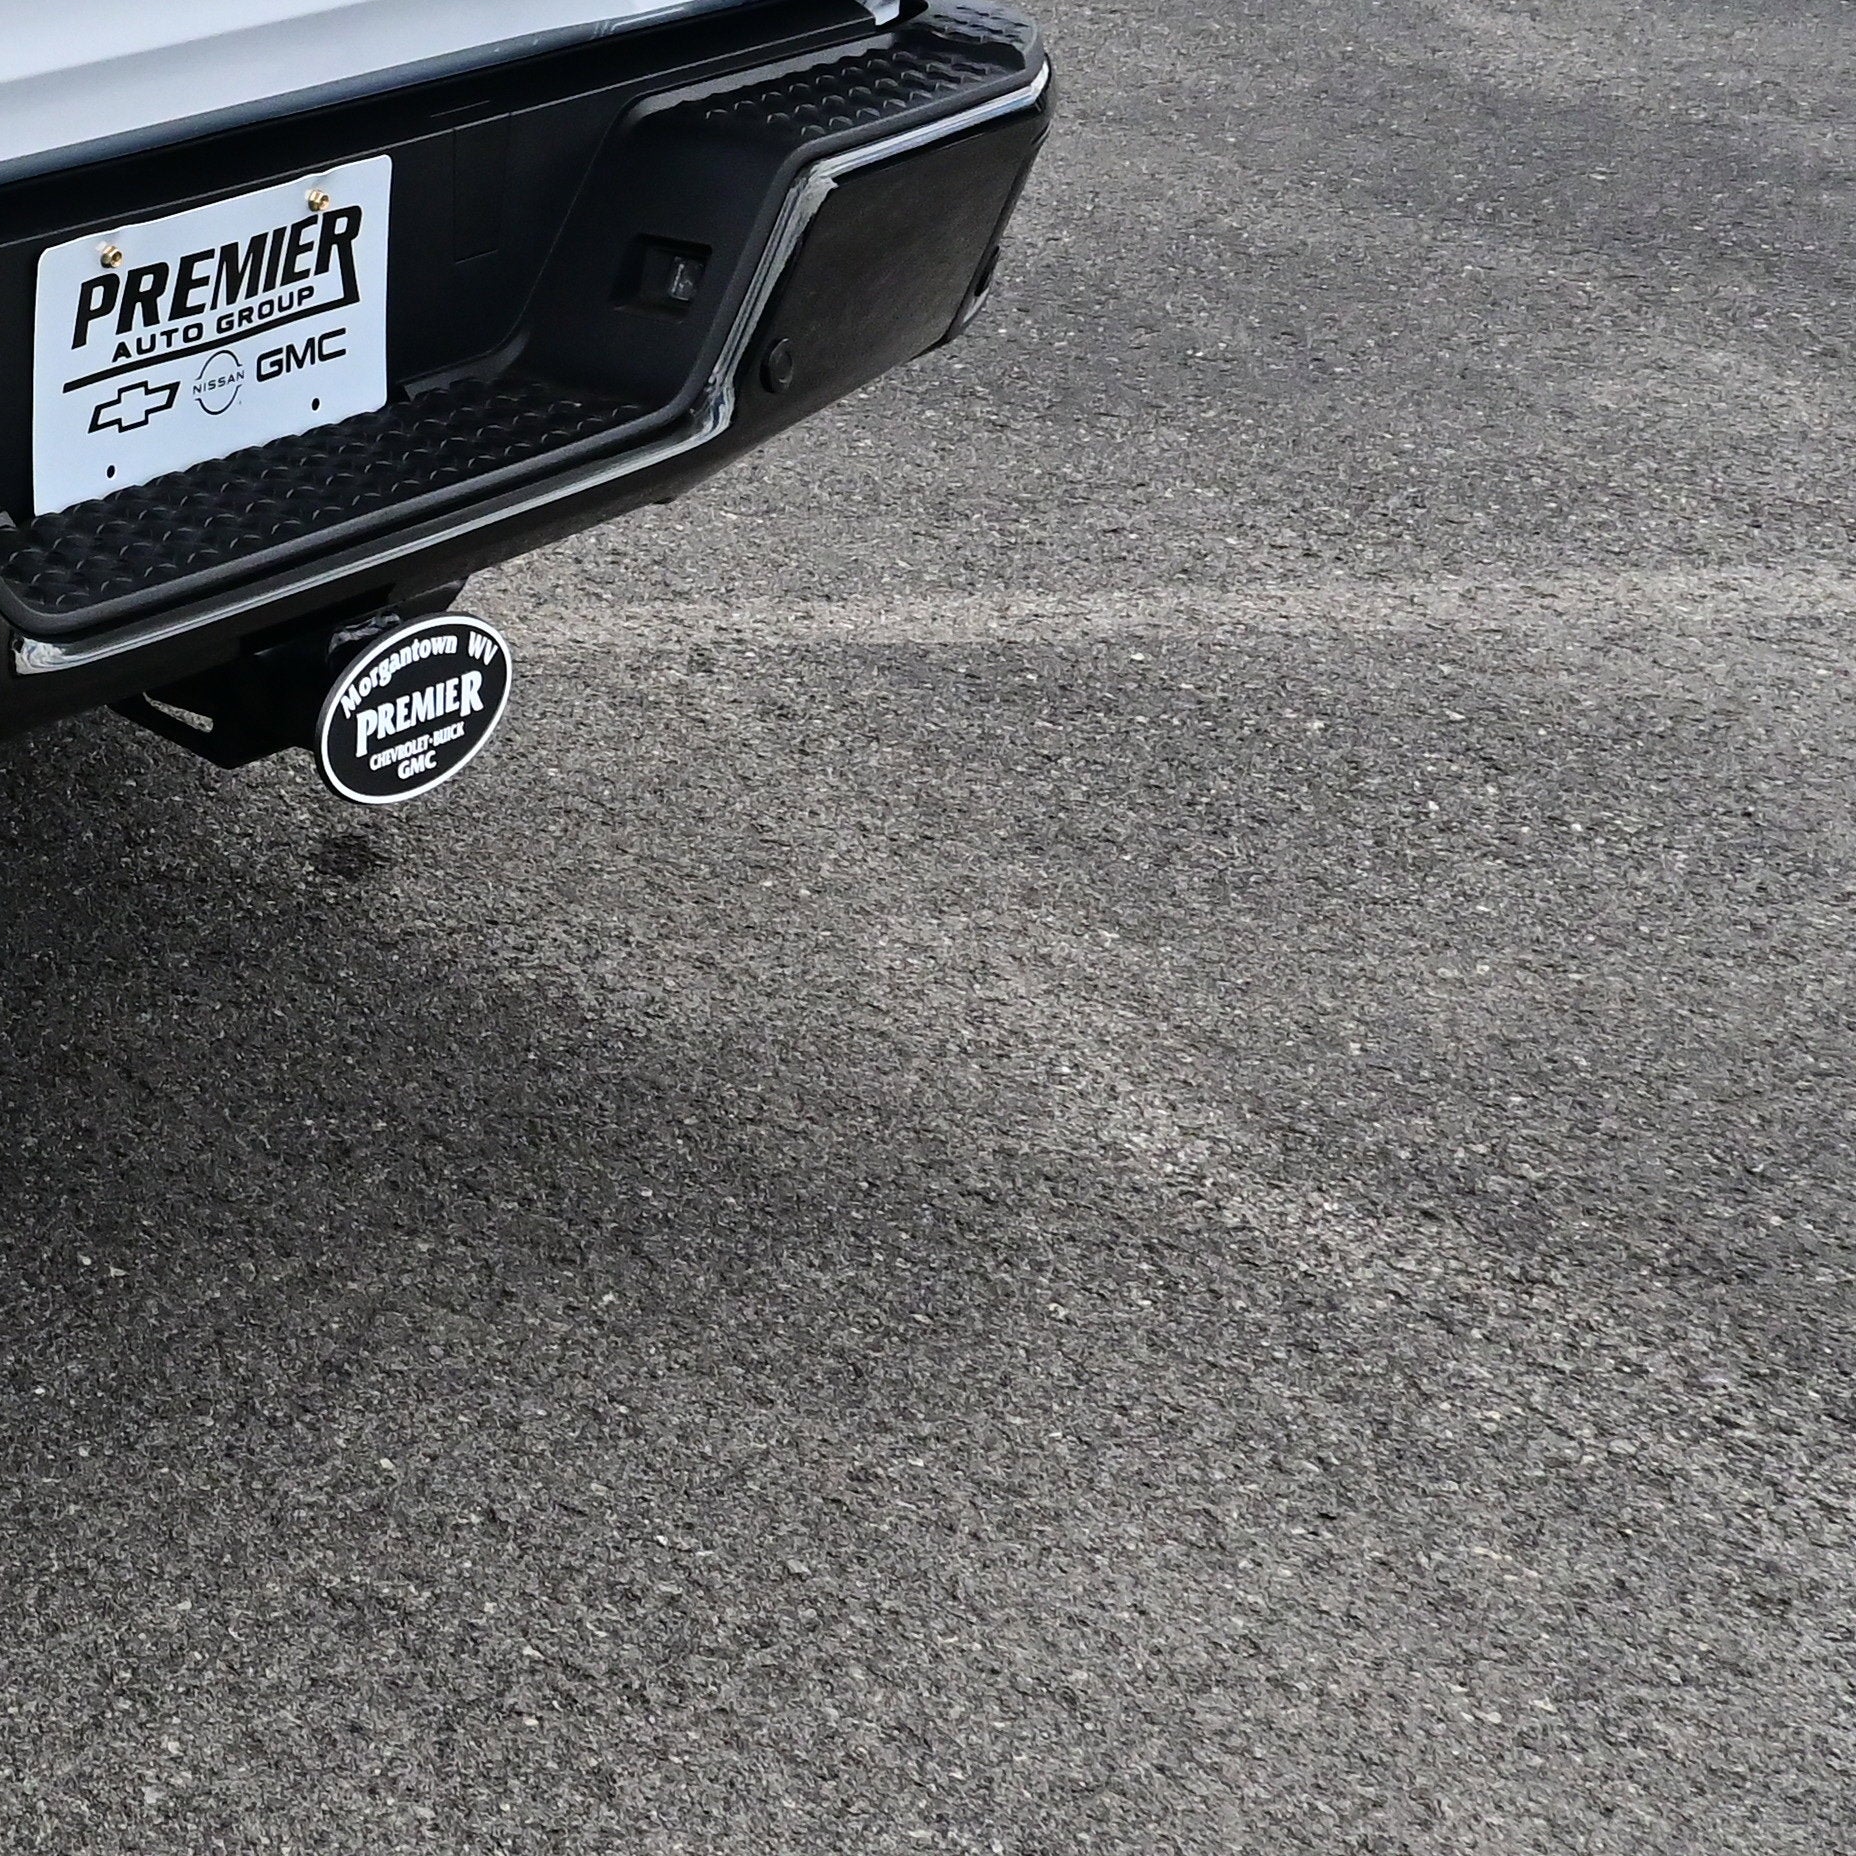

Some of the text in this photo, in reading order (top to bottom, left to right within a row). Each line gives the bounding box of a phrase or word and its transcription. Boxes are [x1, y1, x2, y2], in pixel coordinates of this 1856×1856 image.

[71, 204, 364, 351] PREMIER
[111, 285, 315, 363] AUTO GROUP
[256, 327, 347, 383] GMC
[192, 369, 245, 395] NISSAN
[340, 630, 499, 720] Morgantown WV
[355, 670, 485, 758] PREMIER
[397, 750, 438, 780] GMC
